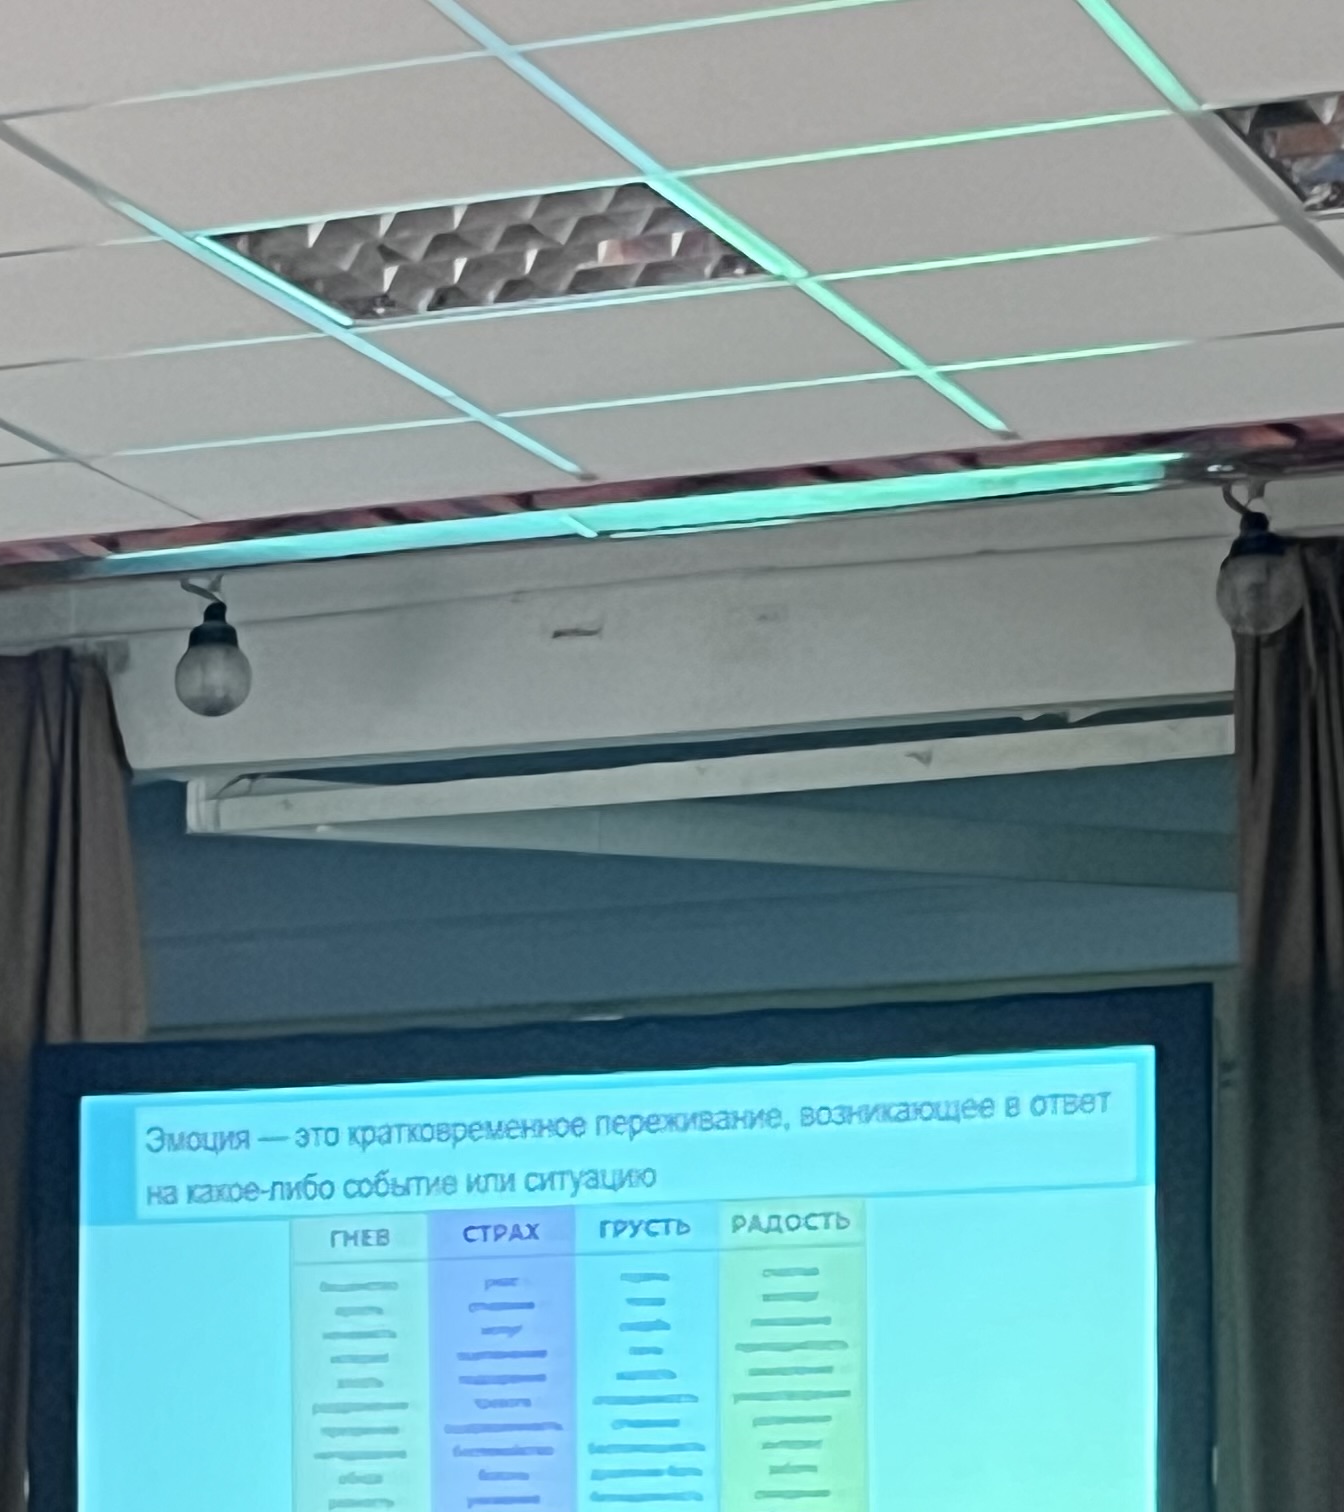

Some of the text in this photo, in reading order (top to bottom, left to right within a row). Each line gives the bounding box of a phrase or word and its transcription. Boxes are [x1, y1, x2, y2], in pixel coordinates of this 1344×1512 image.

[146, 1126, 250, 1155] Эмоция
[295, 1125, 339, 1148] это
[347, 1114, 587, 1151] кратковременное
[595, 1105, 790, 1141] переживание,
[800, 1097, 995, 1128] возникающее
[1005, 1096, 1021, 1117] в
[1030, 1091, 1112, 1117] ответ
[146, 1165, 657, 1207] на какое-либо событие или ситуацию
[462, 1223, 540, 1243] СТРАХ
[599, 1217, 691, 1239] ГРУСТЬ
[731, 1211, 851, 1234] РАДОСТЬ
[330, 1228, 390, 1248] ГНЕВ
